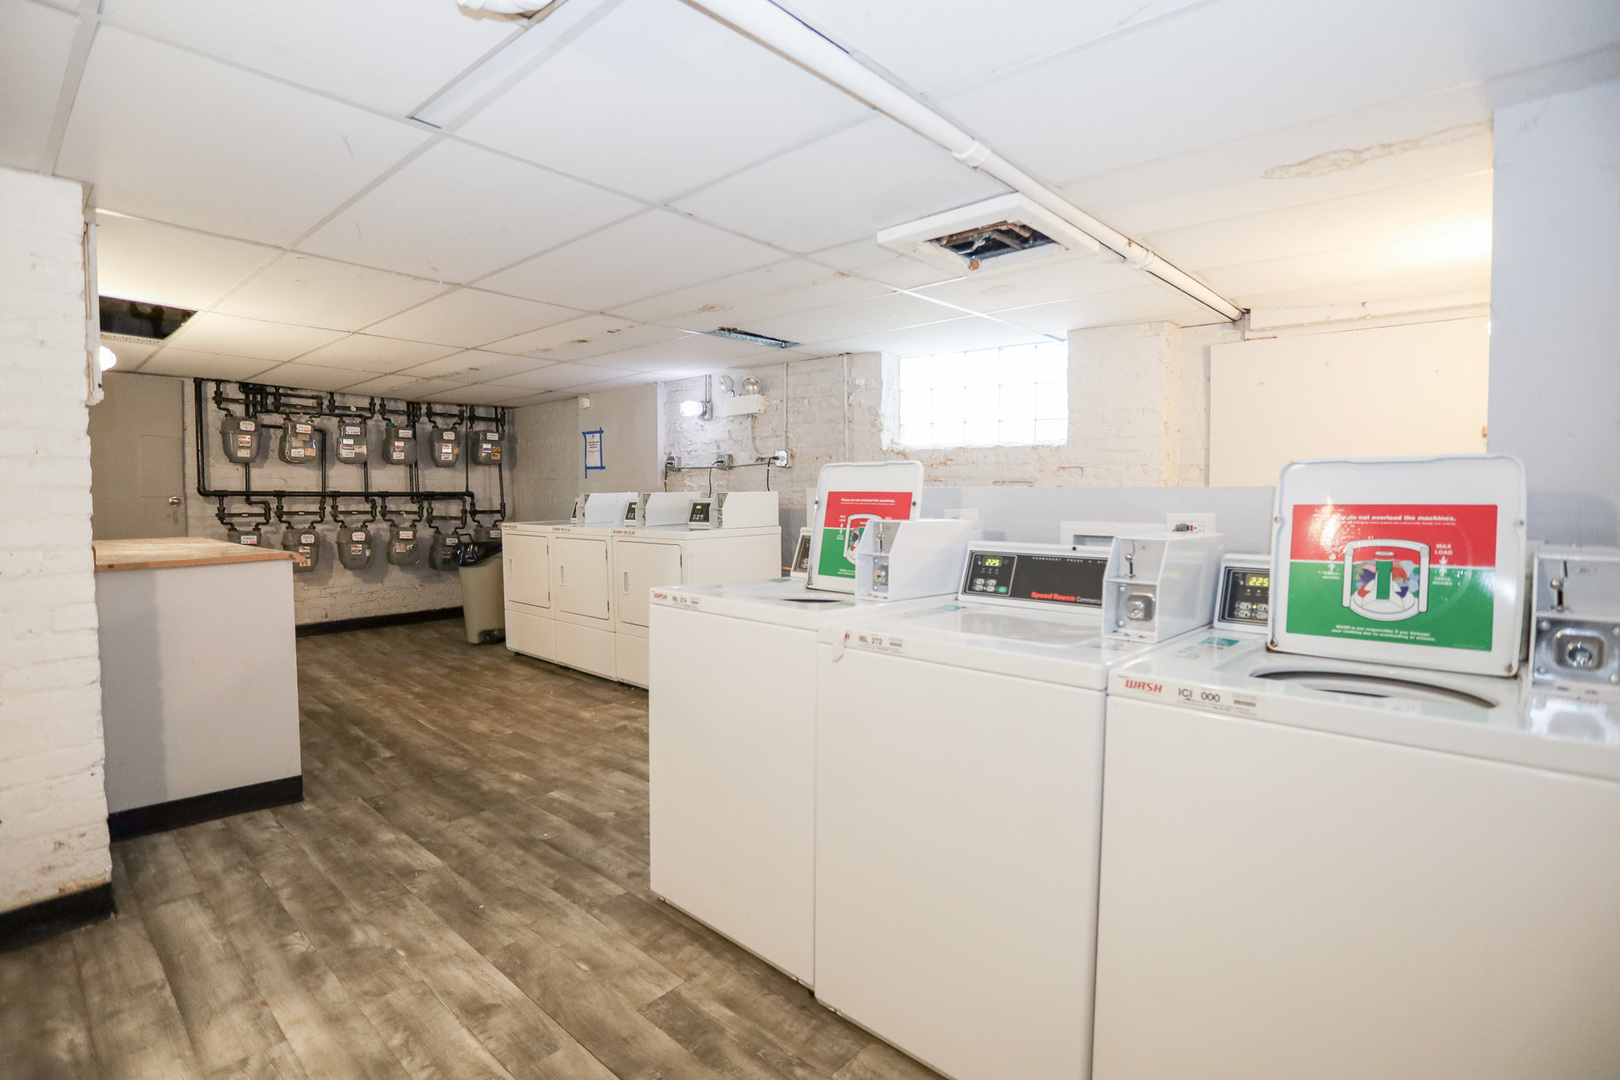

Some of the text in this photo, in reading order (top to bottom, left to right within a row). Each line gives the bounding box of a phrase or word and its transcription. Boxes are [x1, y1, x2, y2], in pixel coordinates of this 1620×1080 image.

[985, 558, 1000, 567] 225
[1249, 576, 1269, 587] 225
[1053, 593, 1076, 602] Queen
[1125, 679, 1163, 694] WASH
